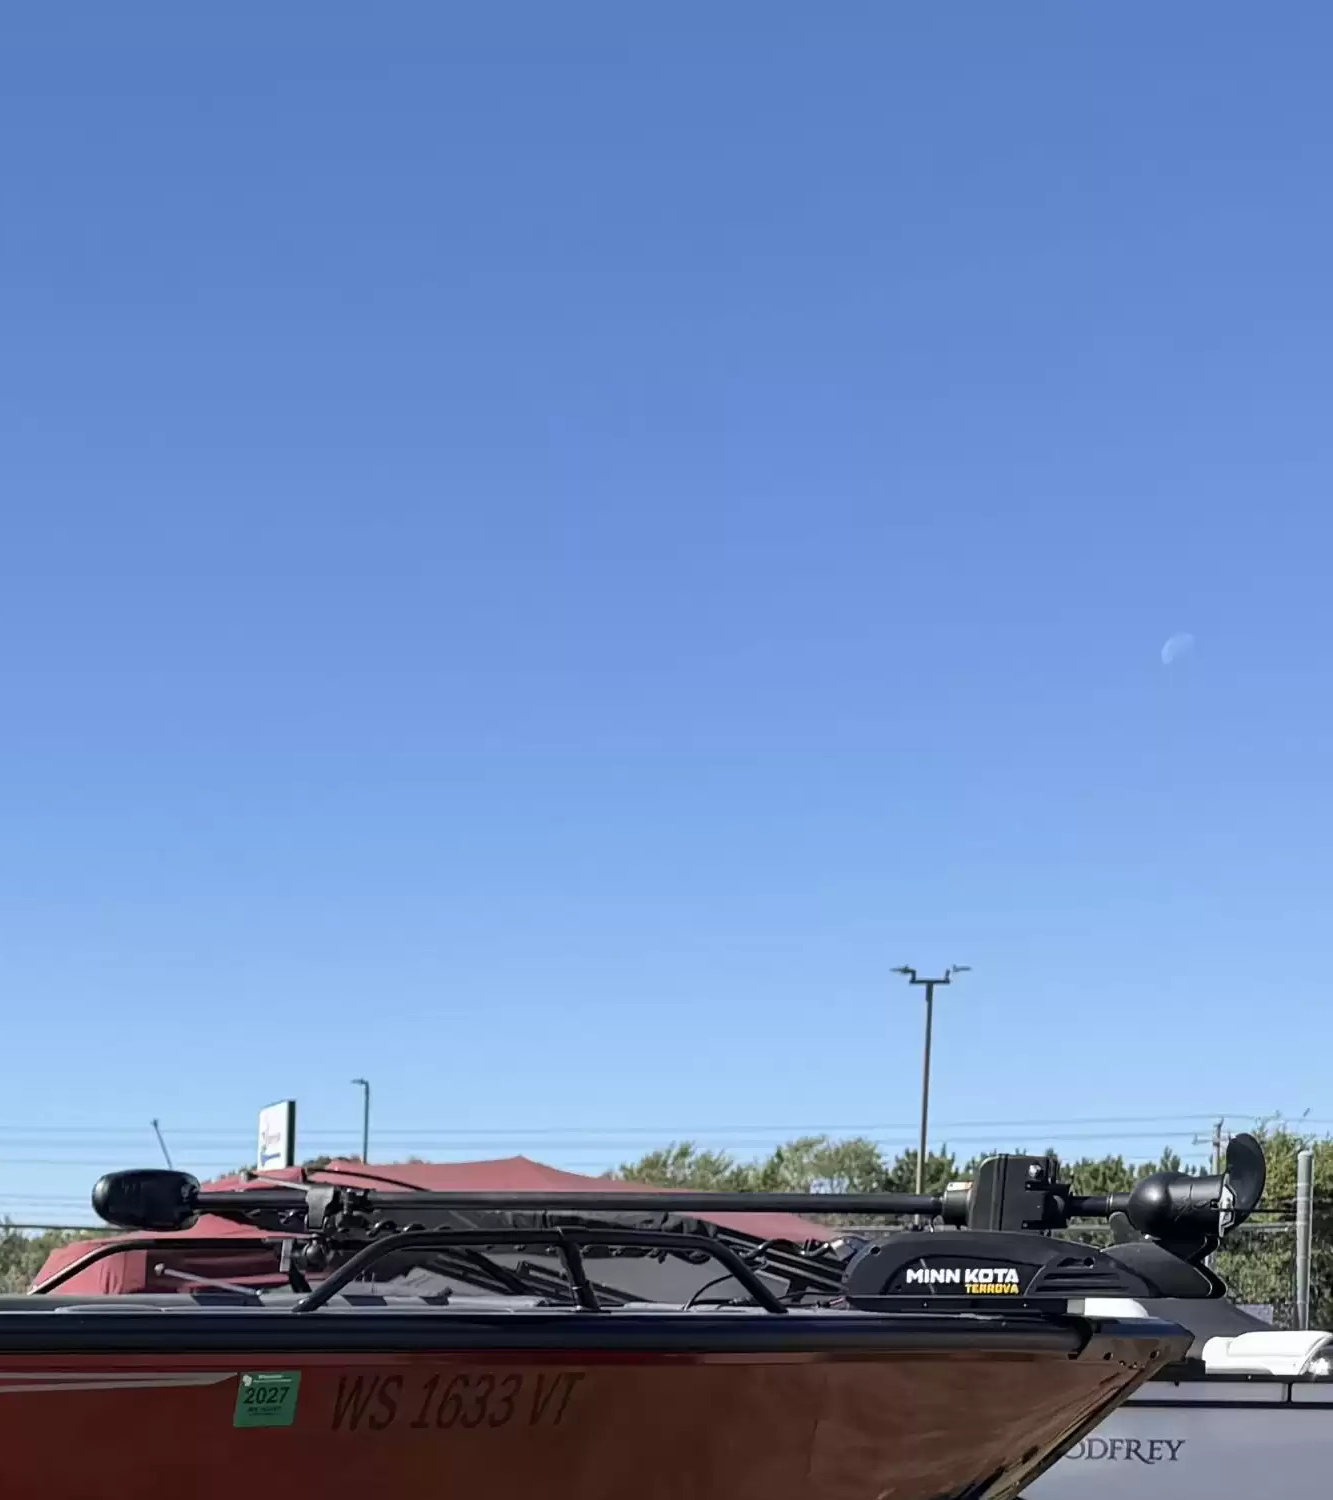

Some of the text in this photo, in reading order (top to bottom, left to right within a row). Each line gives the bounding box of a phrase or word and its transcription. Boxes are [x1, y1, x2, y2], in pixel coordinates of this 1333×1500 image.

[906, 1268, 1019, 1284] MINN KOTA
[964, 1283, 1019, 1295] TERROVA
[243, 1386, 290, 1405] 2027
[331, 1371, 586, 1431] WS 1633 VT
[1064, 1437, 1186, 1465] ODFREY
